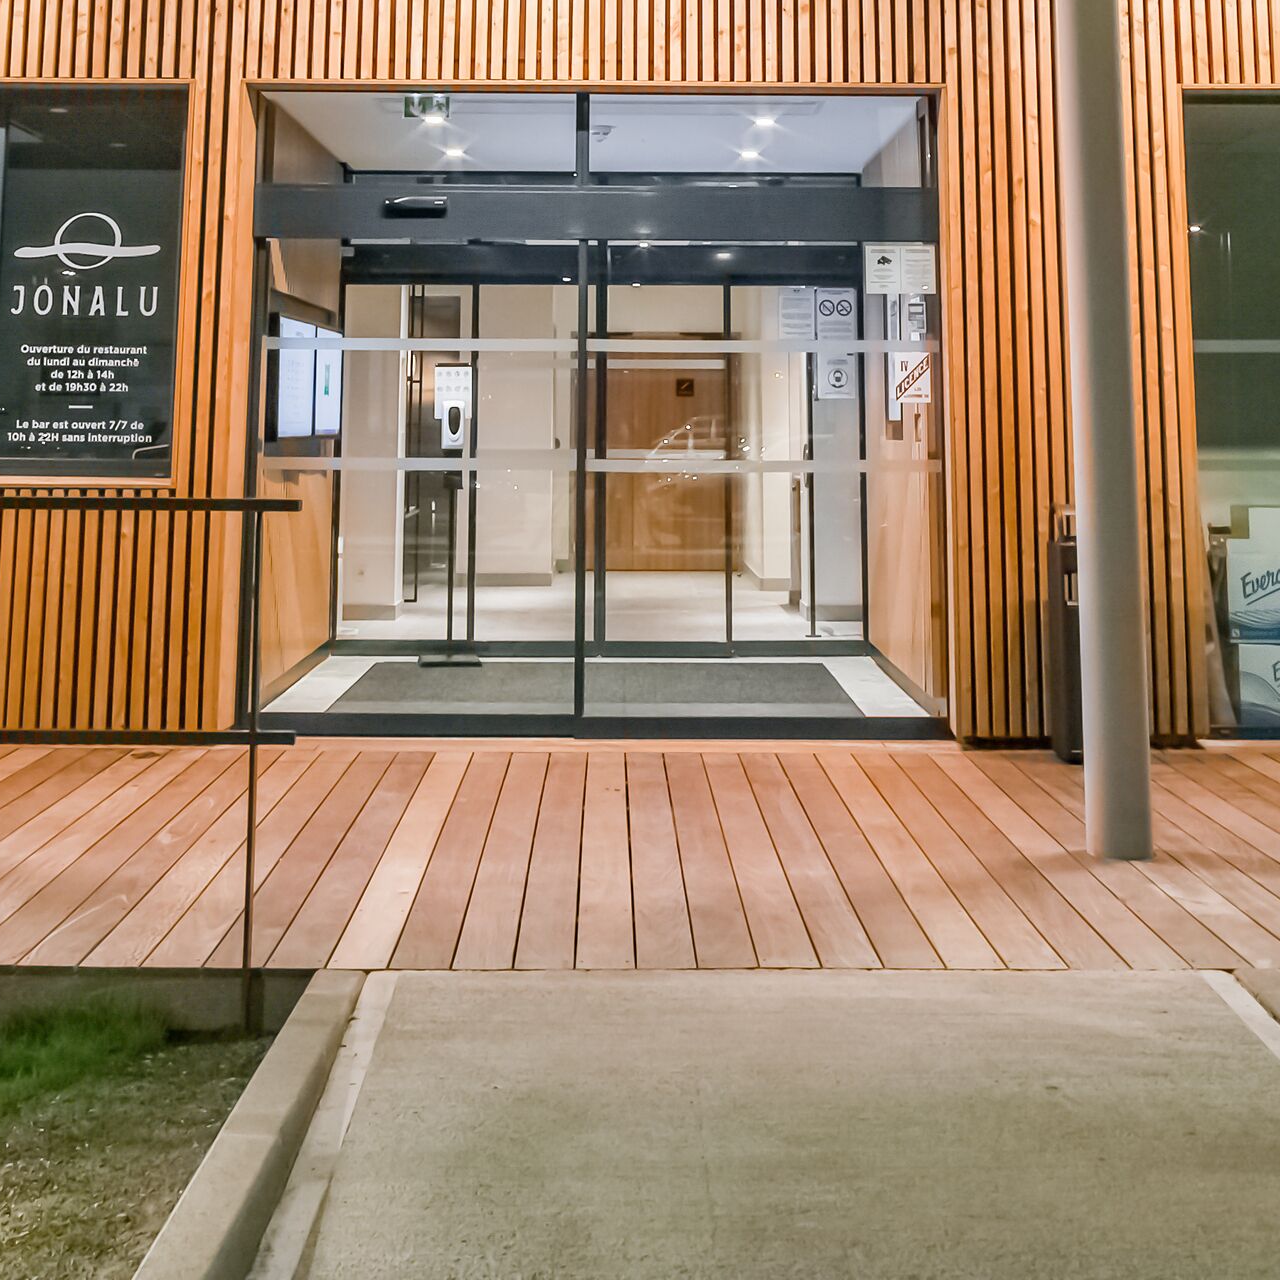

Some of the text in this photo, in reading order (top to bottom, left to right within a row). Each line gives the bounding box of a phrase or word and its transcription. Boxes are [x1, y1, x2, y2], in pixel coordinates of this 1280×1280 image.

[10, 284, 159, 317] JONALU
[20, 344, 148, 355] Ouverture du restaurant
[26, 357, 140, 367] du lundi au dimanche
[50, 369, 114, 379] de 12h à 14h
[896, 356, 930, 399] LICENCE
[35, 382, 128, 392] et de 19h30 à 22h
[16, 419, 144, 431] Le bar est ouvert 7/7 de
[7, 432, 26, 442] 10h
[28, 432, 35, 442] à
[61, 434, 85, 442] sans
[87, 433, 152, 444] interruption
